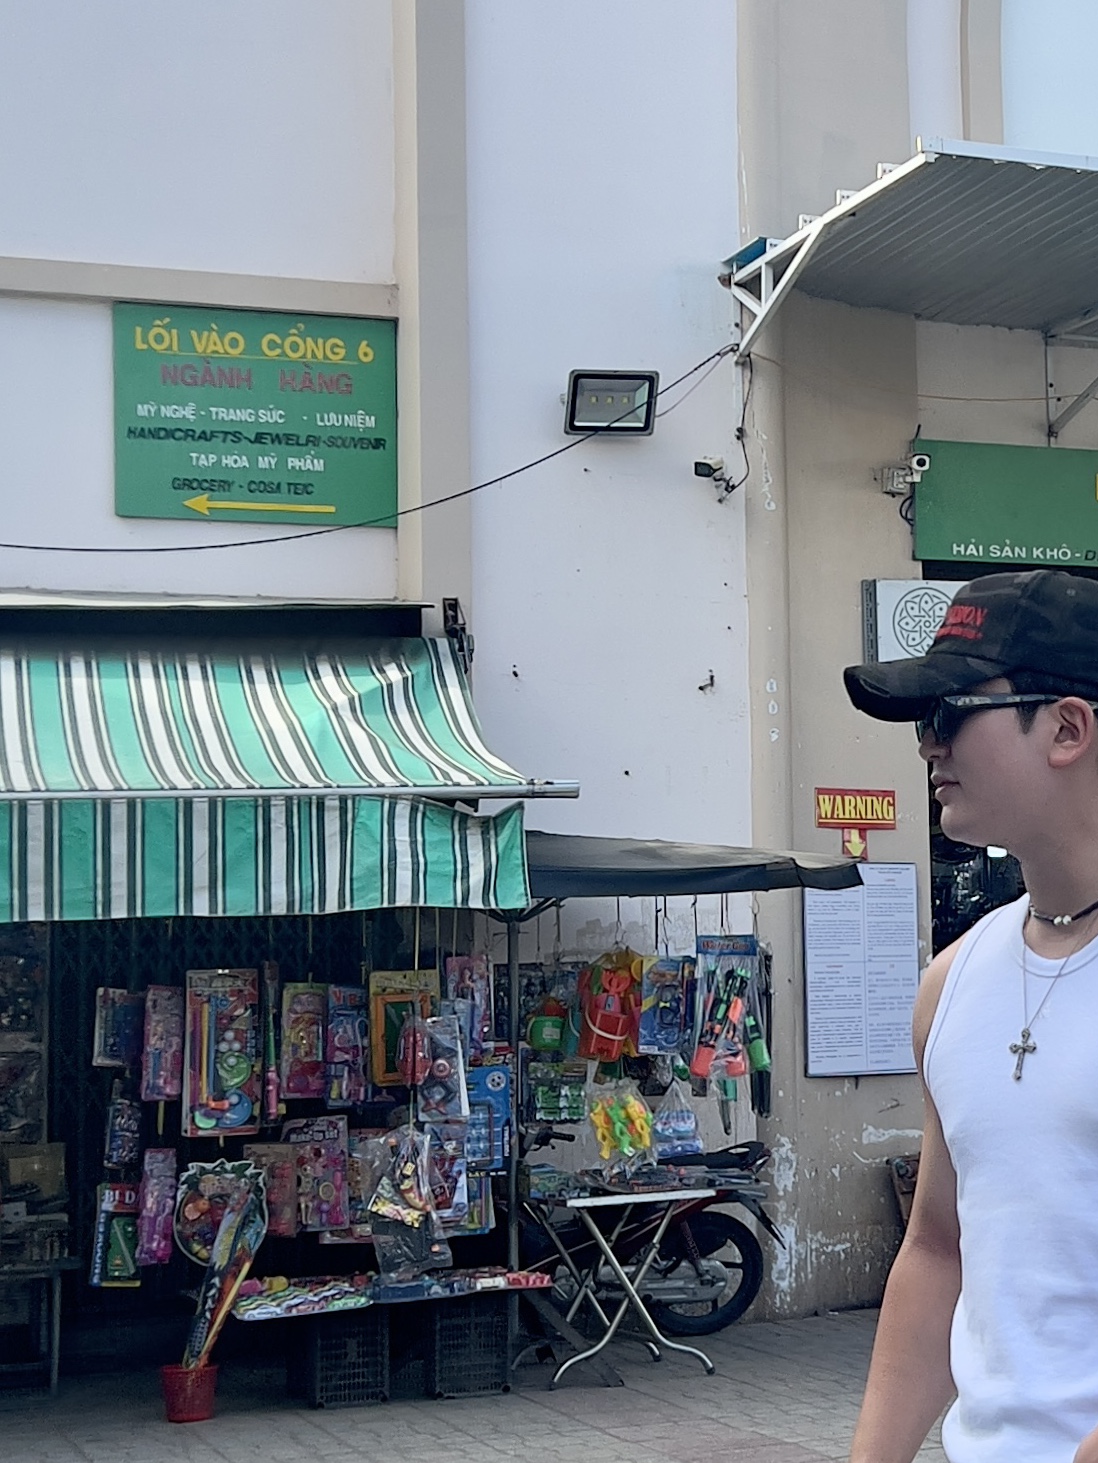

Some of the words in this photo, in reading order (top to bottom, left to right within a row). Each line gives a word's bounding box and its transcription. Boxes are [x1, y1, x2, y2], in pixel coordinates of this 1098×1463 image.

[134, 317, 179, 352] LỐI
[190, 322, 246, 355] VÀO
[260, 322, 346, 361] CỔNG
[358, 340, 375, 362] 6
[160, 358, 253, 390] NGÀNH
[279, 362, 353, 394] HÀNG
[160, 403, 197, 422] NGHỆ
[209, 407, 256, 423] TRANG
[344, 410, 376, 432] NIỆM
[952, 539, 984, 557] HẢI
[989, 539, 1026, 559] SẢN
[1033, 543, 1071, 561] KHÔ
[818, 794, 895, 821] WARNING
